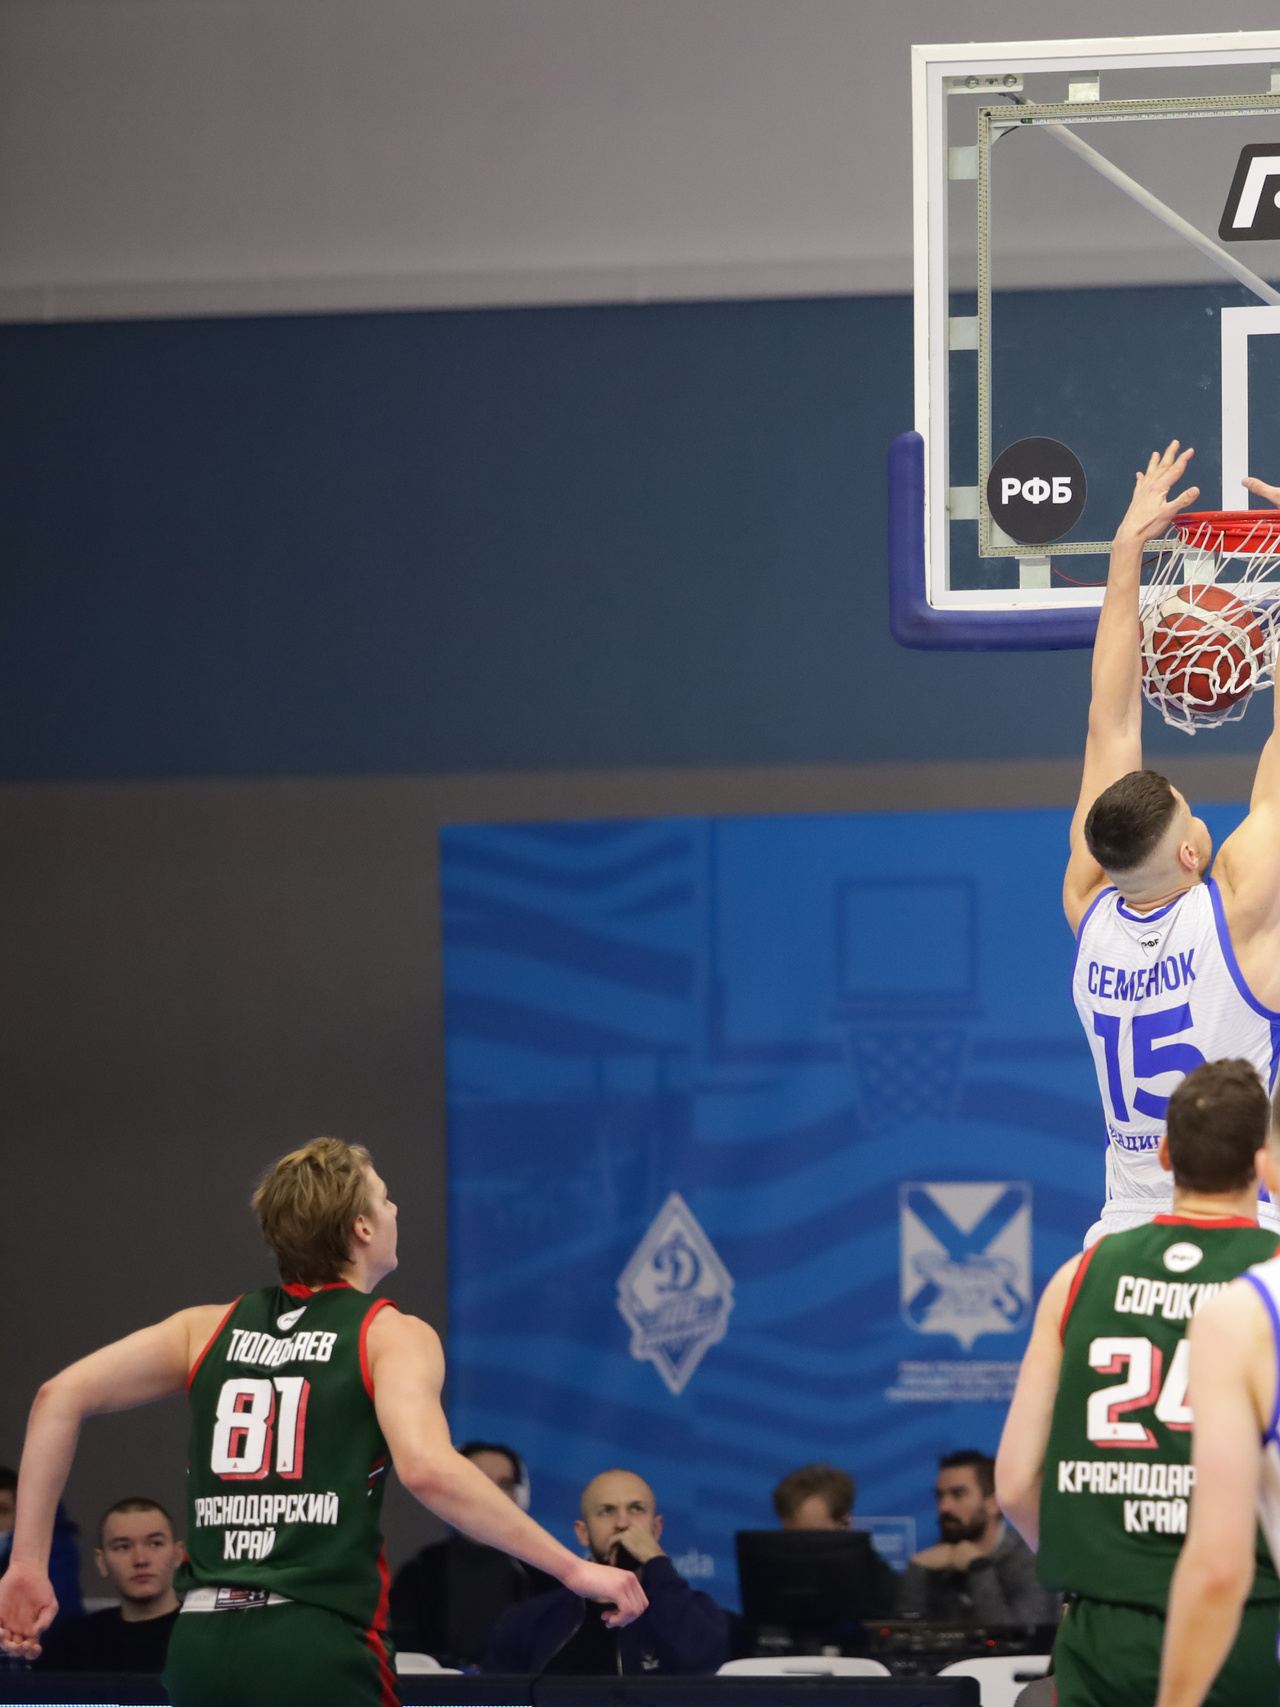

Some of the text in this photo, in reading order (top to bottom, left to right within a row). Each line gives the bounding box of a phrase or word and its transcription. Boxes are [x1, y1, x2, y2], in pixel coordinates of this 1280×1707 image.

[1001, 476, 1072, 505] РФБ
[1092, 1001, 1208, 1123] 15
[1114, 1275, 1228, 1321] СОРОКИ
[210, 1376, 311, 1480] 81
[194, 1491, 339, 1528] РАСНОДАРСКИЙ
[1123, 1499, 1189, 1535] КРАЙ
[223, 1526, 276, 1560] КРАЙ
